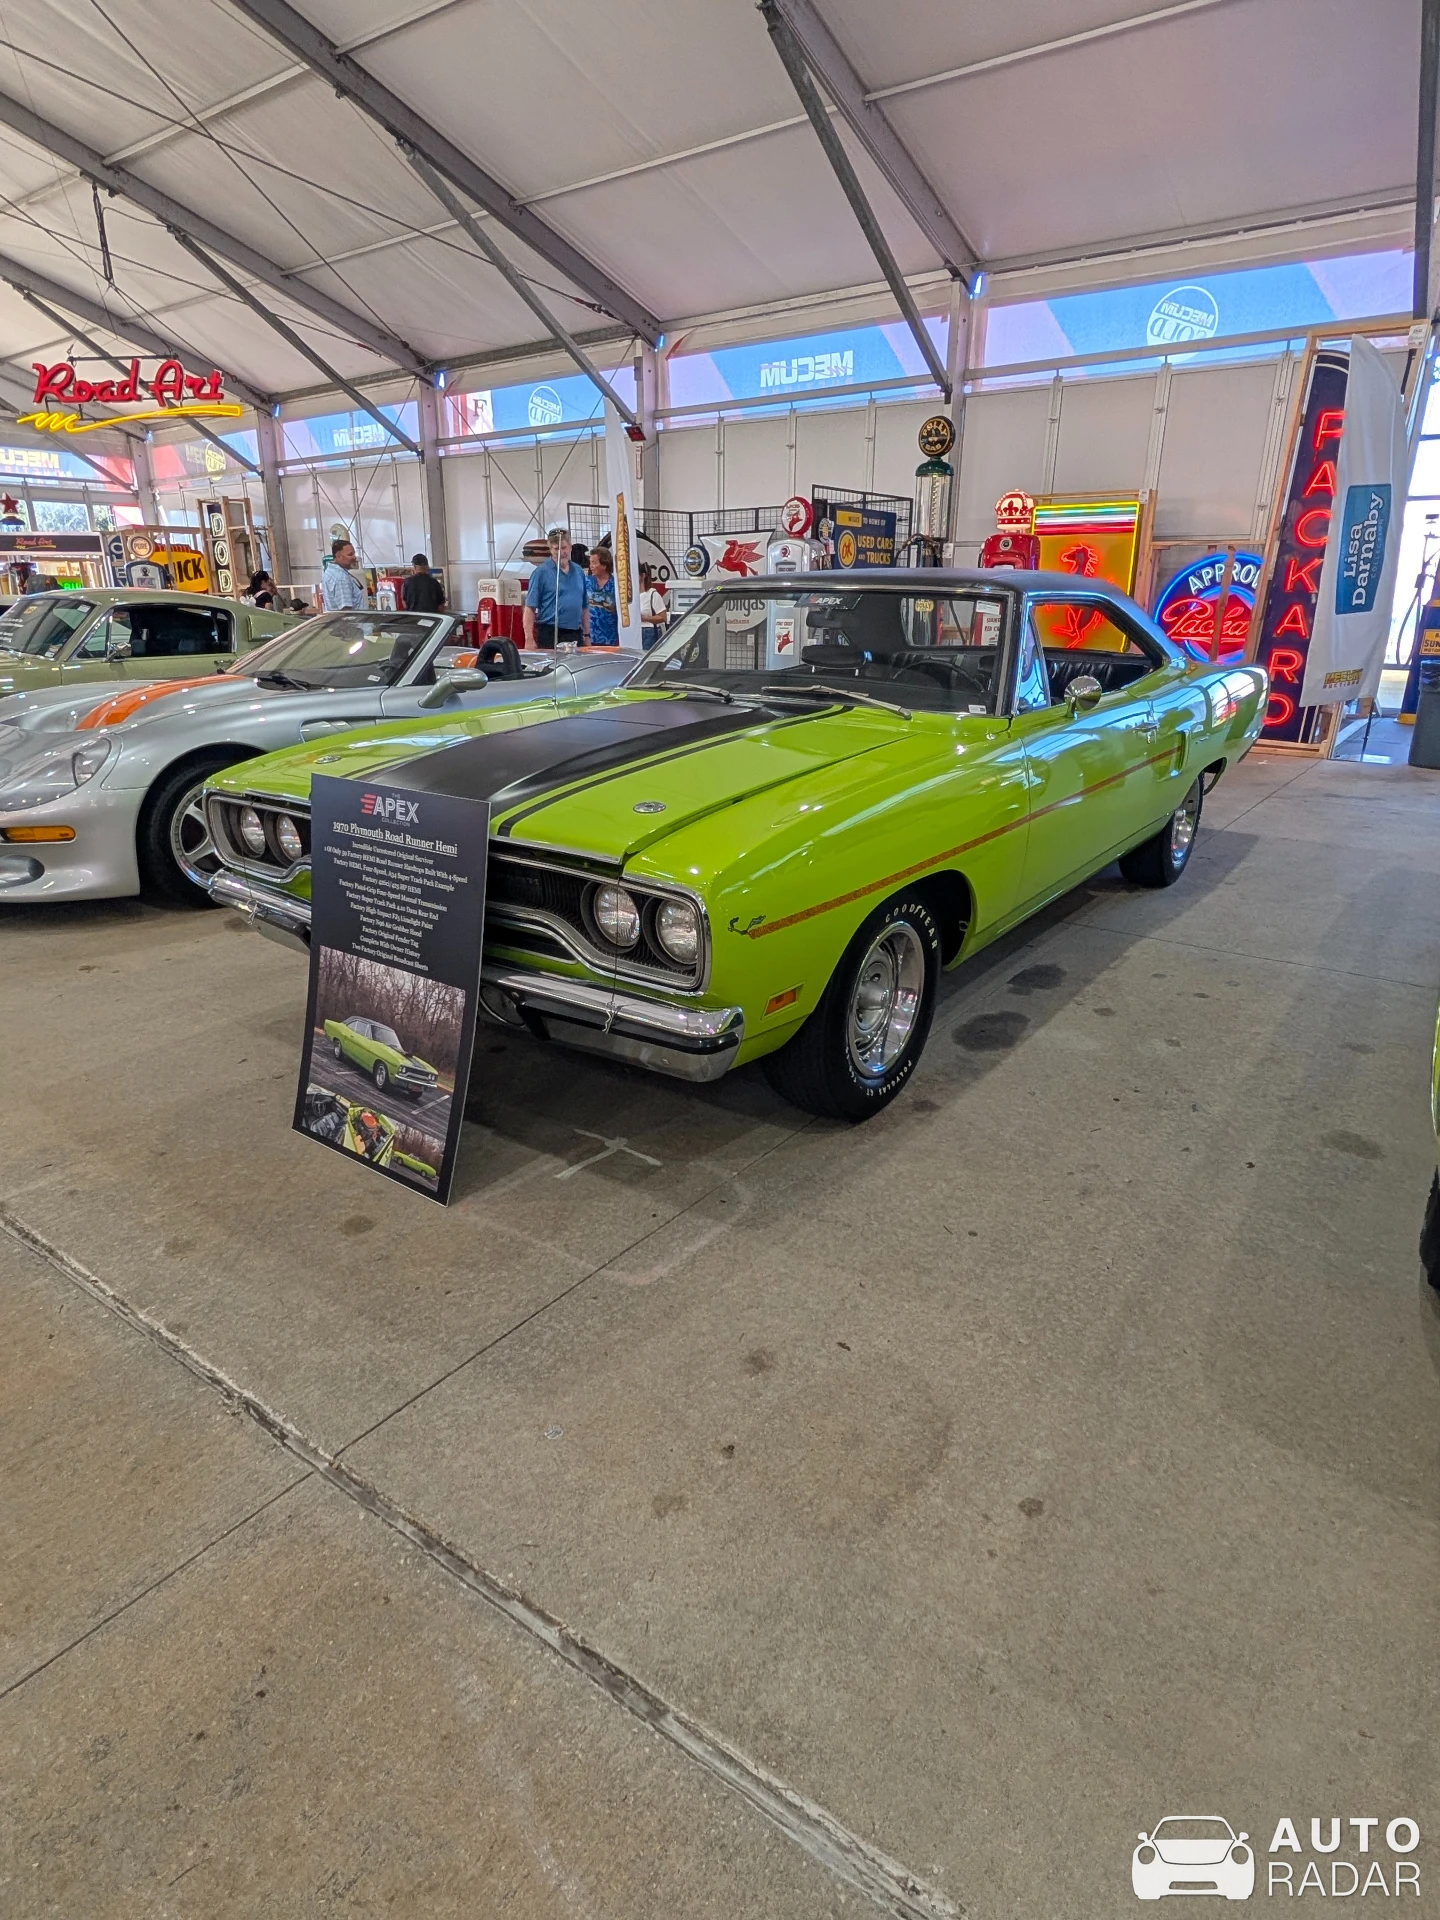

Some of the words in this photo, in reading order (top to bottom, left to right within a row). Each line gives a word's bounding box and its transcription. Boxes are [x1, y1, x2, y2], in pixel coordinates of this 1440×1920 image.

[32, 358, 142, 404] Road
[149, 359, 225, 407] Art
[923, 421, 948, 436] POLLY
[858, 535, 874, 548] USED
[876, 536, 894, 550] CARS
[1352, 492, 1384, 606] Darnaby
[866, 552, 891, 564] TRUCKS
[1343, 523, 1363, 578] Lisa
[373, 797, 420, 824] APEX
[332, 820, 348, 832] 1970
[350, 821, 383, 840] Plymouth
[384, 829, 404, 844] Road
[405, 834, 434, 850] Runner
[435, 839, 457, 855] Hemi
[347, 850, 362, 860] Factory
[376, 856, 386, 864] Road
[387, 859, 402, 868] Runner
[333, 857, 348, 867] Factory
[397, 872, 409, 881] Super
[339, 878, 354, 889] Factory
[362, 874, 377, 884] Factory
[346, 890, 360, 901] Factory
[350, 901, 365, 912] Factory
[359, 914, 374, 924] Factory
[885, 903, 938, 949] GOODYEAR
[362, 925, 377, 935] Factory
[378, 930, 394, 940] Original
[361, 945, 375, 955] Factory
